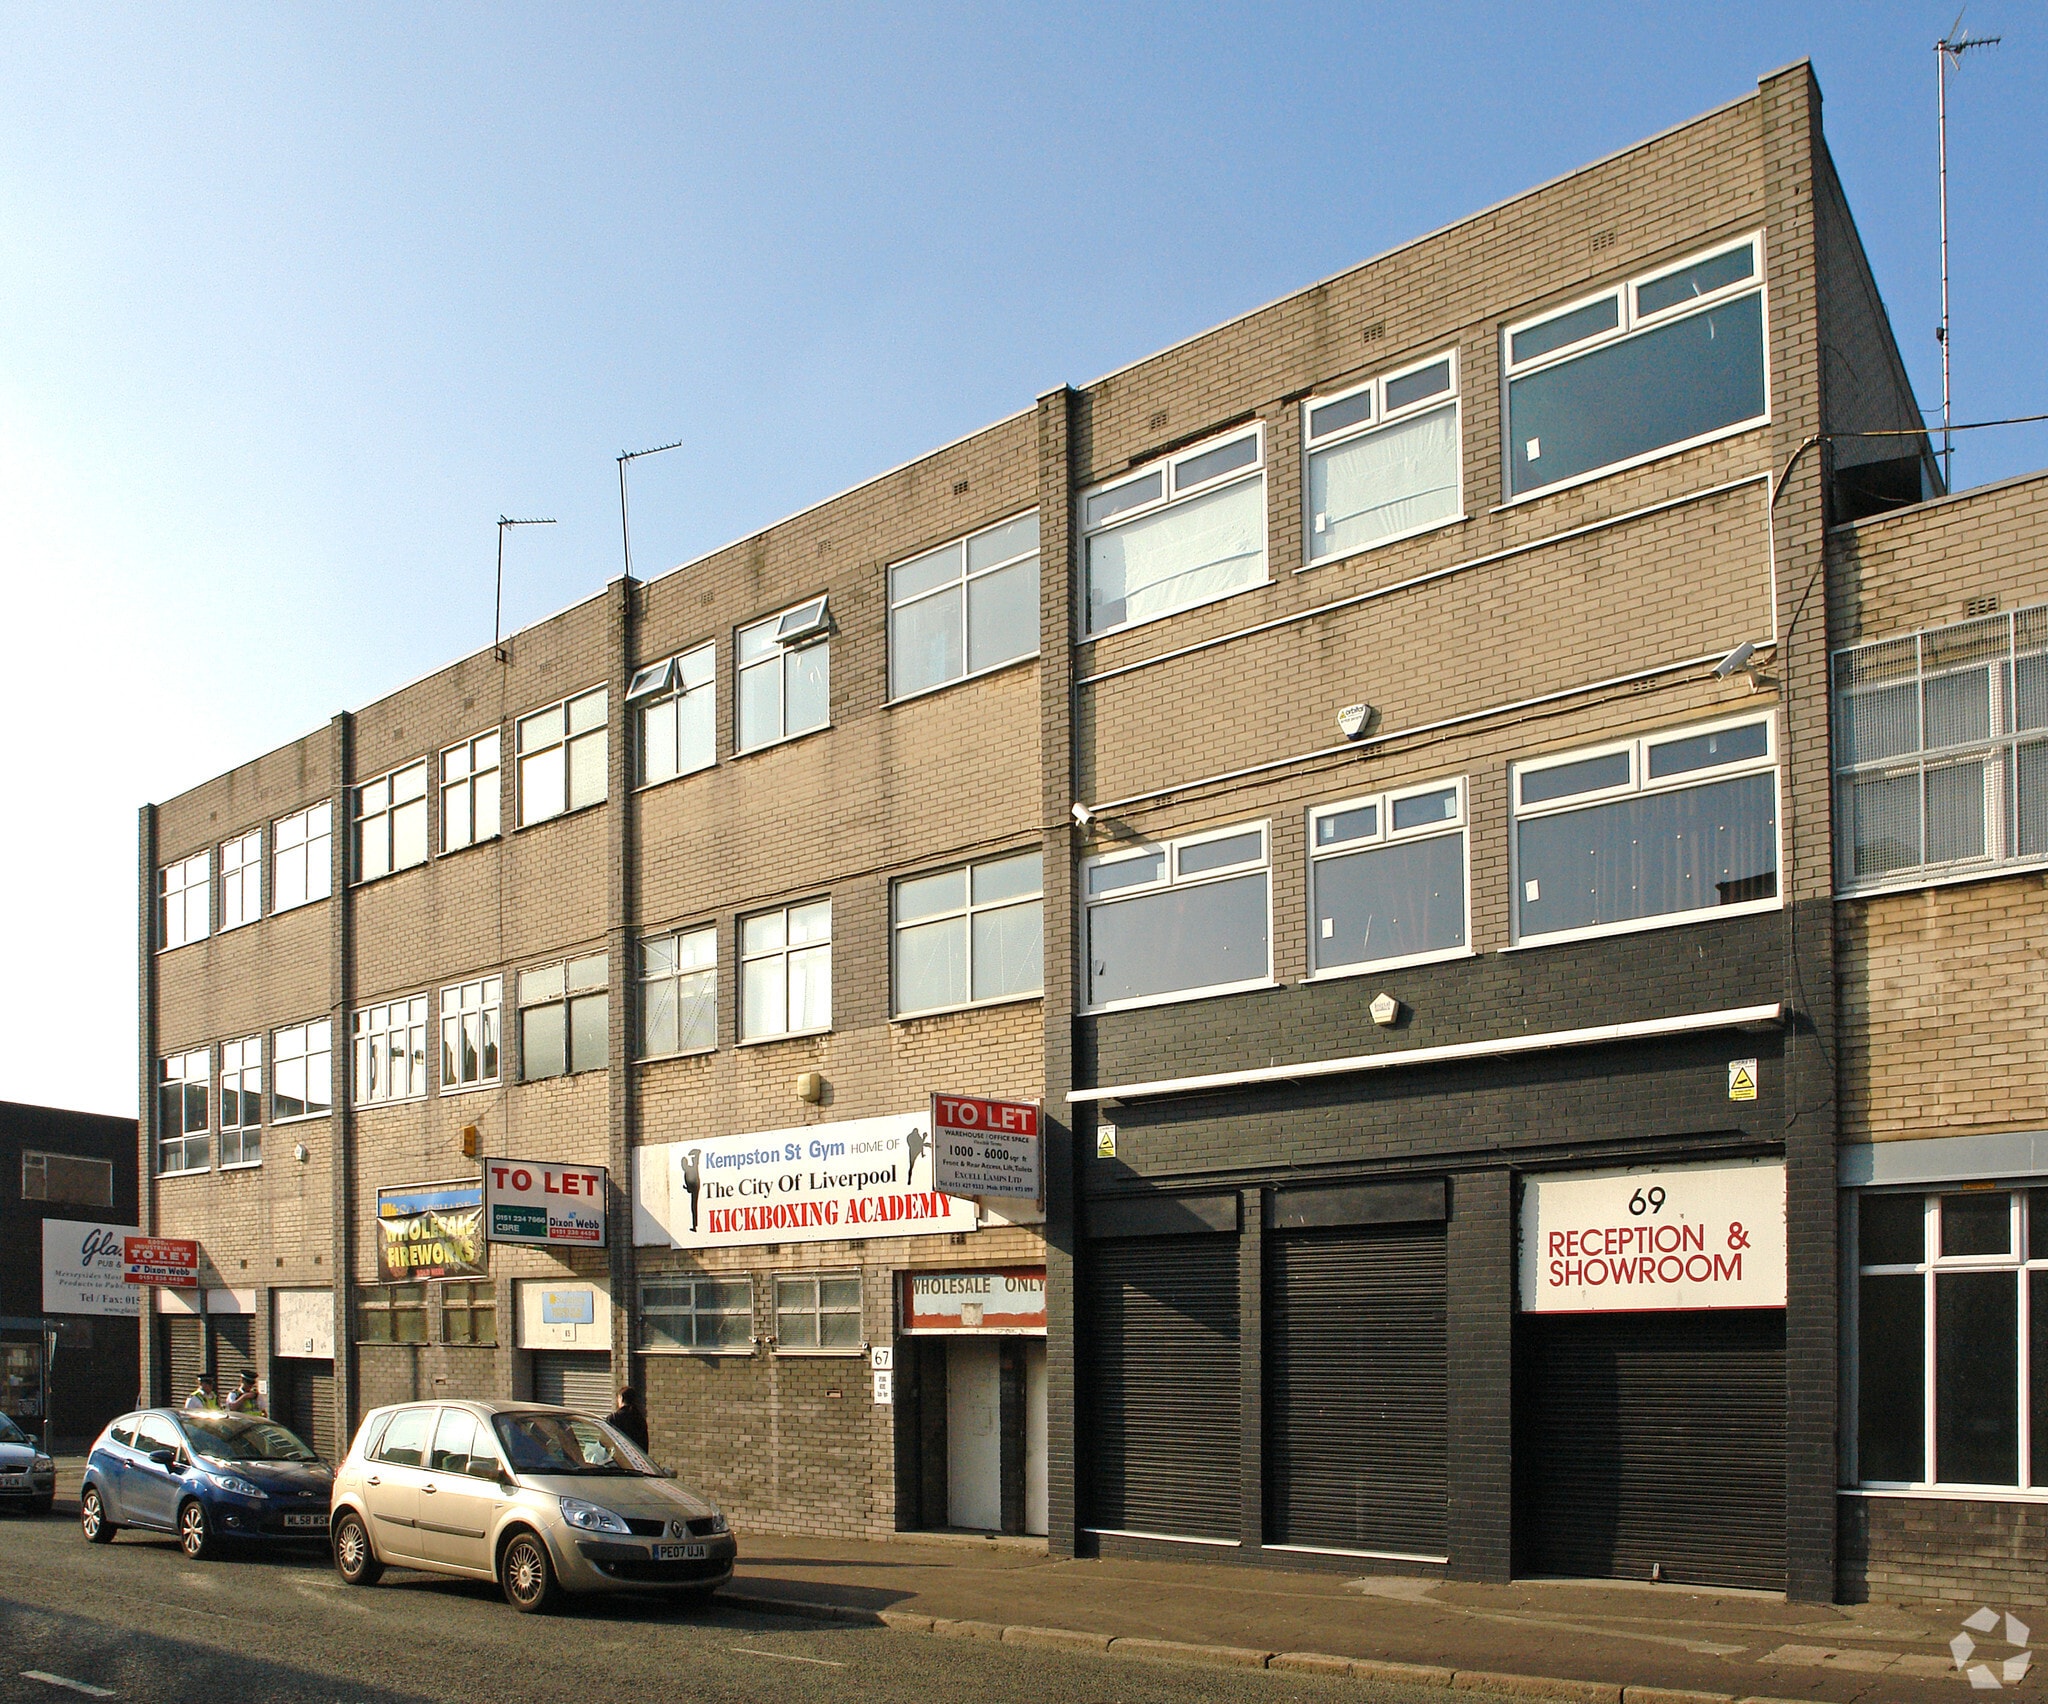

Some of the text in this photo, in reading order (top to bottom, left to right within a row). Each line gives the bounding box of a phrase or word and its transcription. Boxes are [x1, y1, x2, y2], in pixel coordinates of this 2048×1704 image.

[942, 1100, 1032, 1131] TO LET
[944, 1129, 984, 1139] WAREHOUSE
[989, 1134, 1010, 1142] OFFICE
[1011, 1136, 1029, 1144] SPACE
[705, 1138, 901, 1171] Kempston St Gym HOME OF
[949, 1144, 974, 1157] 1000
[984, 1148, 1009, 1160] 6000
[942, 1159, 959, 1167] Front
[491, 1167, 599, 1196] TO LET
[703, 1165, 898, 1199] The City Of Liverpool
[954, 1170, 980, 1180] EXCELL
[1628, 1186, 1666, 1216] 69
[495, 1214, 511, 1222] 0151
[513, 1215, 526, 1223] 224
[708, 1190, 952, 1234] KICKBOXING ACADEMY
[385, 1214, 475, 1243] WHOLESALE
[496, 1223, 520, 1232] CBRE
[549, 1217, 600, 1230] Dixon Webb
[1549, 1221, 1751, 1257] RECEPTION &
[130, 1249, 191, 1261] TO LET
[387, 1240, 475, 1268] FIREWORKS
[97, 1259, 122, 1269] PUB &
[144, 1265, 191, 1276] Dixon Webb
[1549, 1253, 1742, 1287] SHOWROOM
[59, 1279, 93, 1287] Products
[913, 1277, 1046, 1294] WHOLESALE ONLY
[81, 1293, 94, 1302] Tel
[102, 1294, 123, 1304] Fax:
[874, 1350, 889, 1366] 67
[660, 1545, 705, 1558] PE07 UJA
